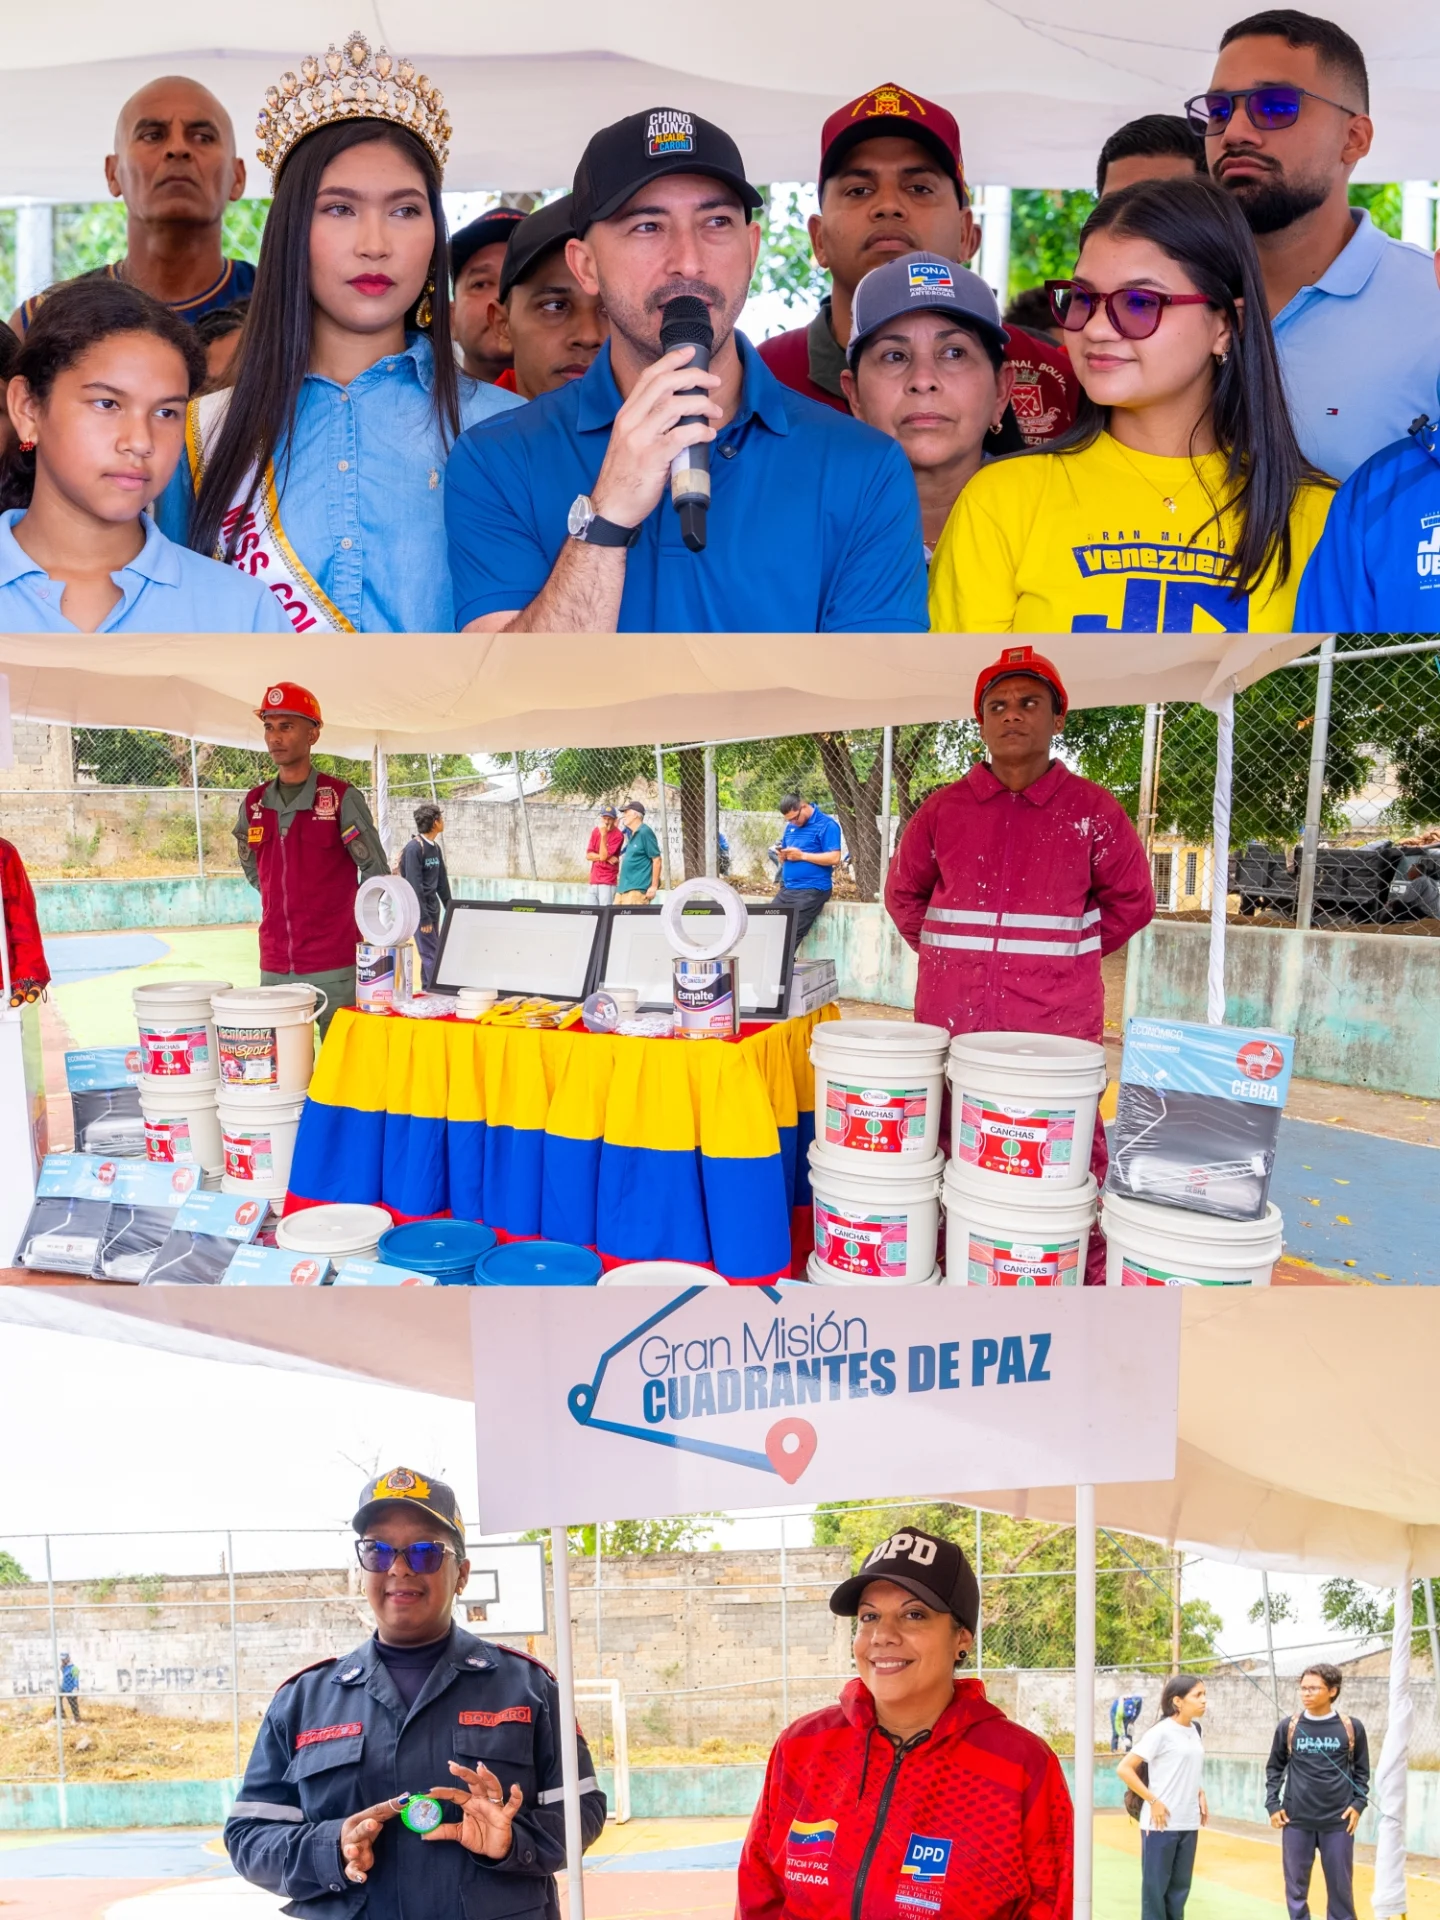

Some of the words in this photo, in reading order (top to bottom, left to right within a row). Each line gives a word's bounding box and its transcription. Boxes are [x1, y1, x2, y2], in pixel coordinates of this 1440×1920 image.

[650, 111, 691, 126] CHINO
[647, 121, 693, 138] ALONZO
[655, 132, 686, 144] ALCALDE
[912, 267, 947, 276] FONA
[678, 990, 714, 1006] Esmalte
[235, 1042, 272, 1059] Sport
[1231, 1079, 1279, 1102] CEBRA
[854, 1108, 894, 1119] CANCHAS
[990, 1125, 1034, 1140] CANCHAS
[1185, 1184, 1207, 1196] CEBRA
[834, 1228, 871, 1242] CANCHAS
[1003, 1264, 1048, 1274] CANCHAS
[639, 1335, 731, 1377] Gran
[743, 1310, 867, 1363] Misión
[643, 1348, 896, 1424] CUADRANTES
[908, 1341, 960, 1393] DE
[972, 1332, 1052, 1387] PAZ
[864, 1533, 938, 1569] DPD
[1296, 1736, 1341, 1751] PRADA
[912, 1844, 945, 1863] DPD
[813, 1862, 829, 1871] PAZ
[913, 1891, 942, 1903] DELITO
[898, 1903, 935, 1916] DISTRITO
